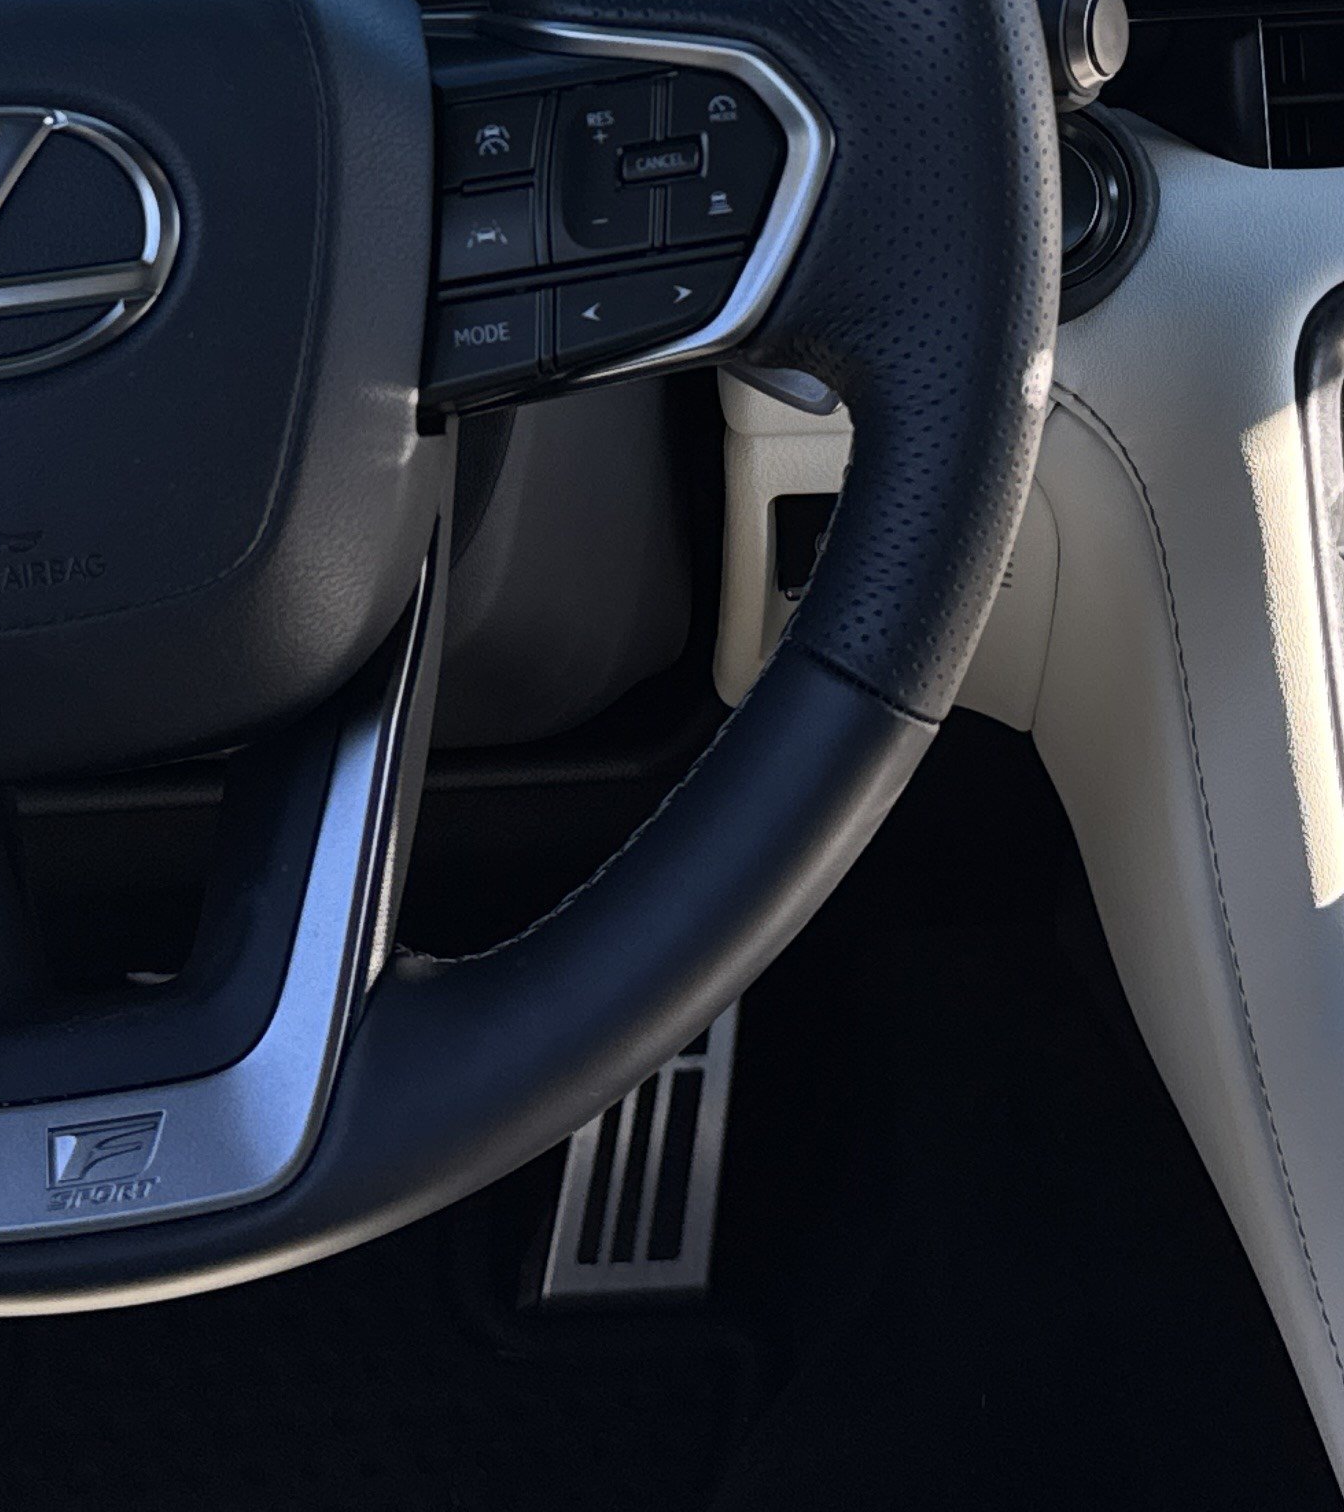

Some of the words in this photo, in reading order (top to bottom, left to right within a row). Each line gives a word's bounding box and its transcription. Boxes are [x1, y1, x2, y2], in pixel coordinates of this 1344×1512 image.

[585, 110, 615, 129] RES
[634, 153, 686, 171] CANCEL
[454, 321, 511, 347] MODE
